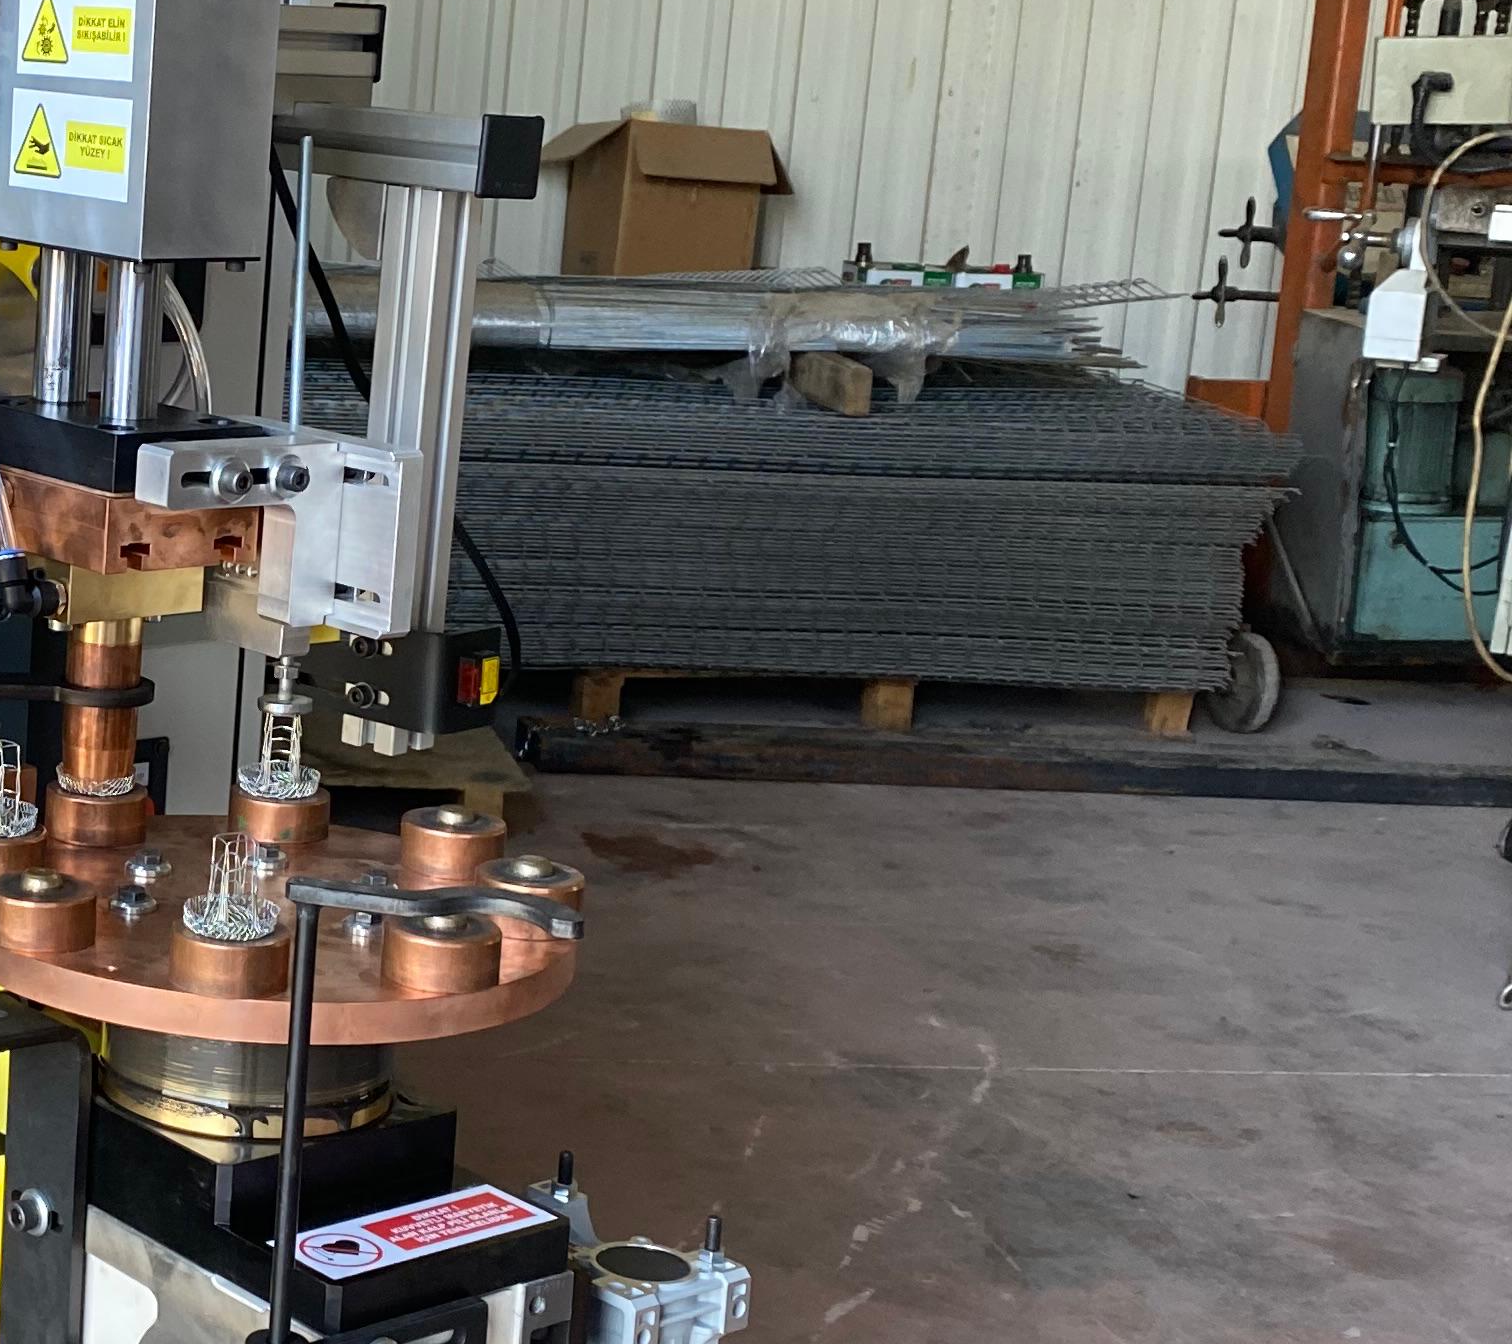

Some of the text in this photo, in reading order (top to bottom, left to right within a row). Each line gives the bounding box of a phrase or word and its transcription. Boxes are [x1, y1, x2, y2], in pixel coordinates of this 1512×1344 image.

[78, 16, 126, 28] DİKKAT ELİN
[68, 131, 123, 147] DİKKAT SICAK
[80, 145, 105, 158] YÜZEY
